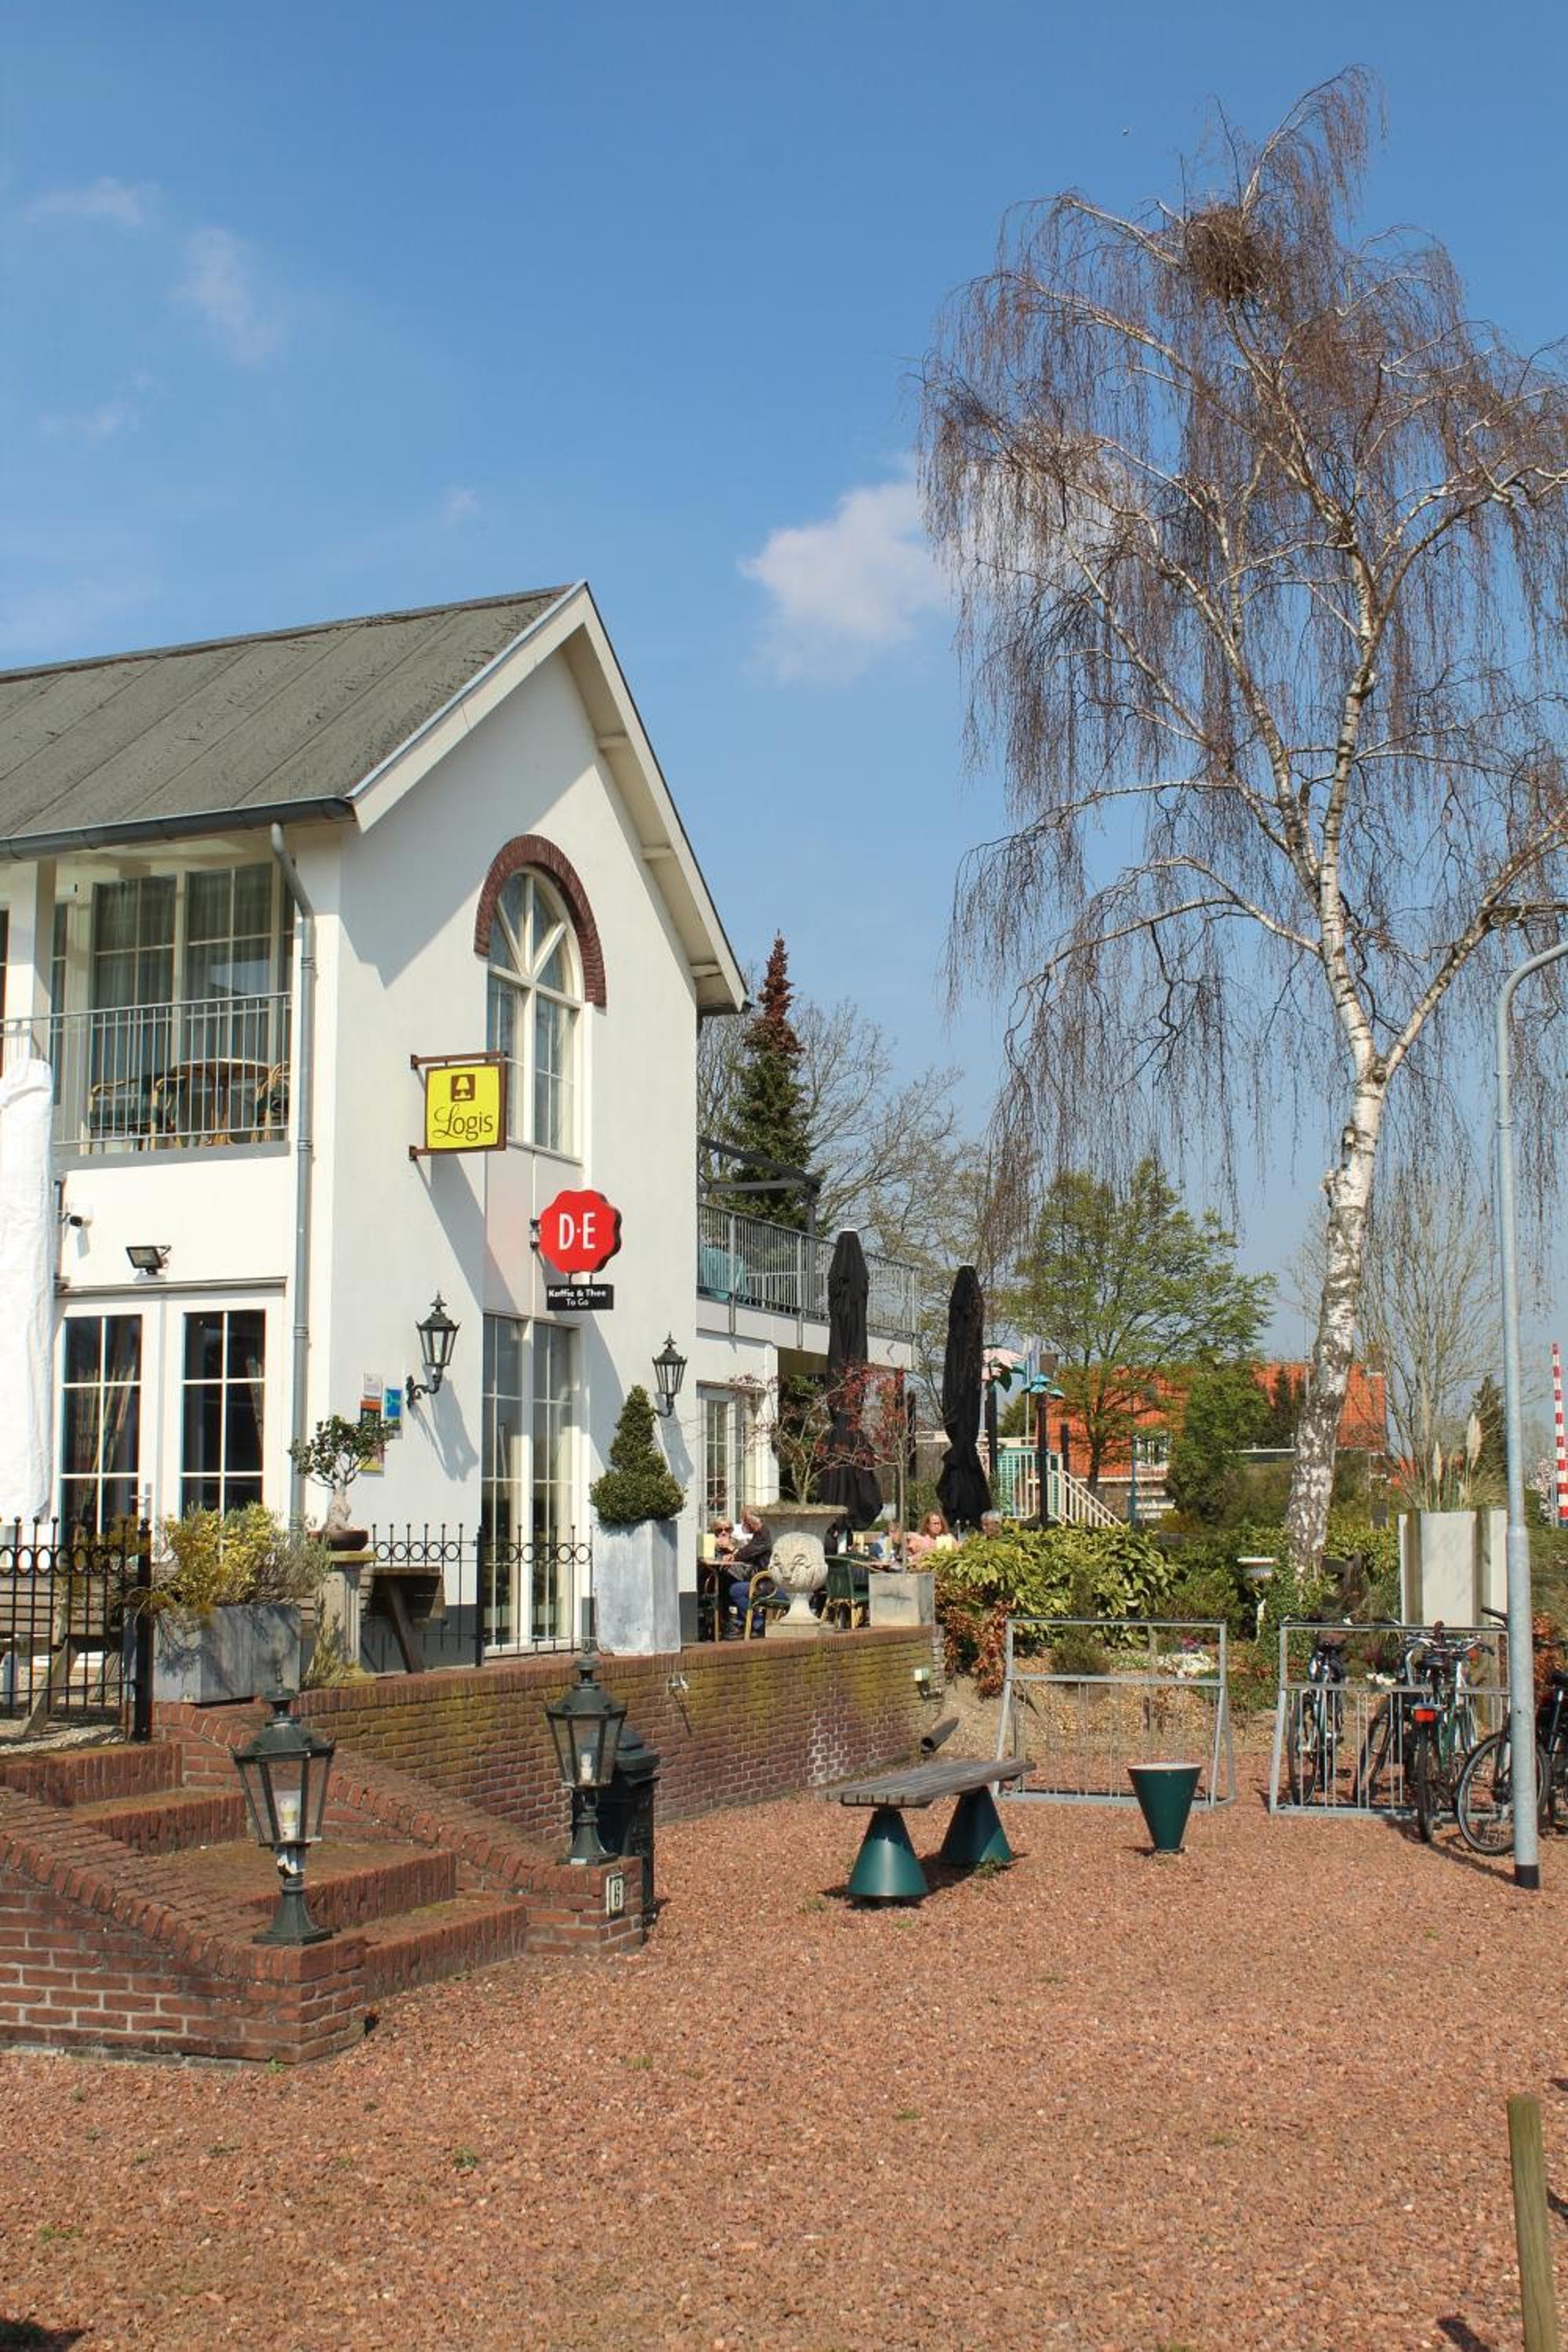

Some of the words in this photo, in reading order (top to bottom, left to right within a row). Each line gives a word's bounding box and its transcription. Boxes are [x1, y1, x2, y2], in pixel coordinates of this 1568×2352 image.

[432, 1103, 493, 1142] Logis
[548, 1288, 575, 1298] Koffie
[576, 1289, 584, 1298] &
[585, 1288, 607, 1298] Thee
